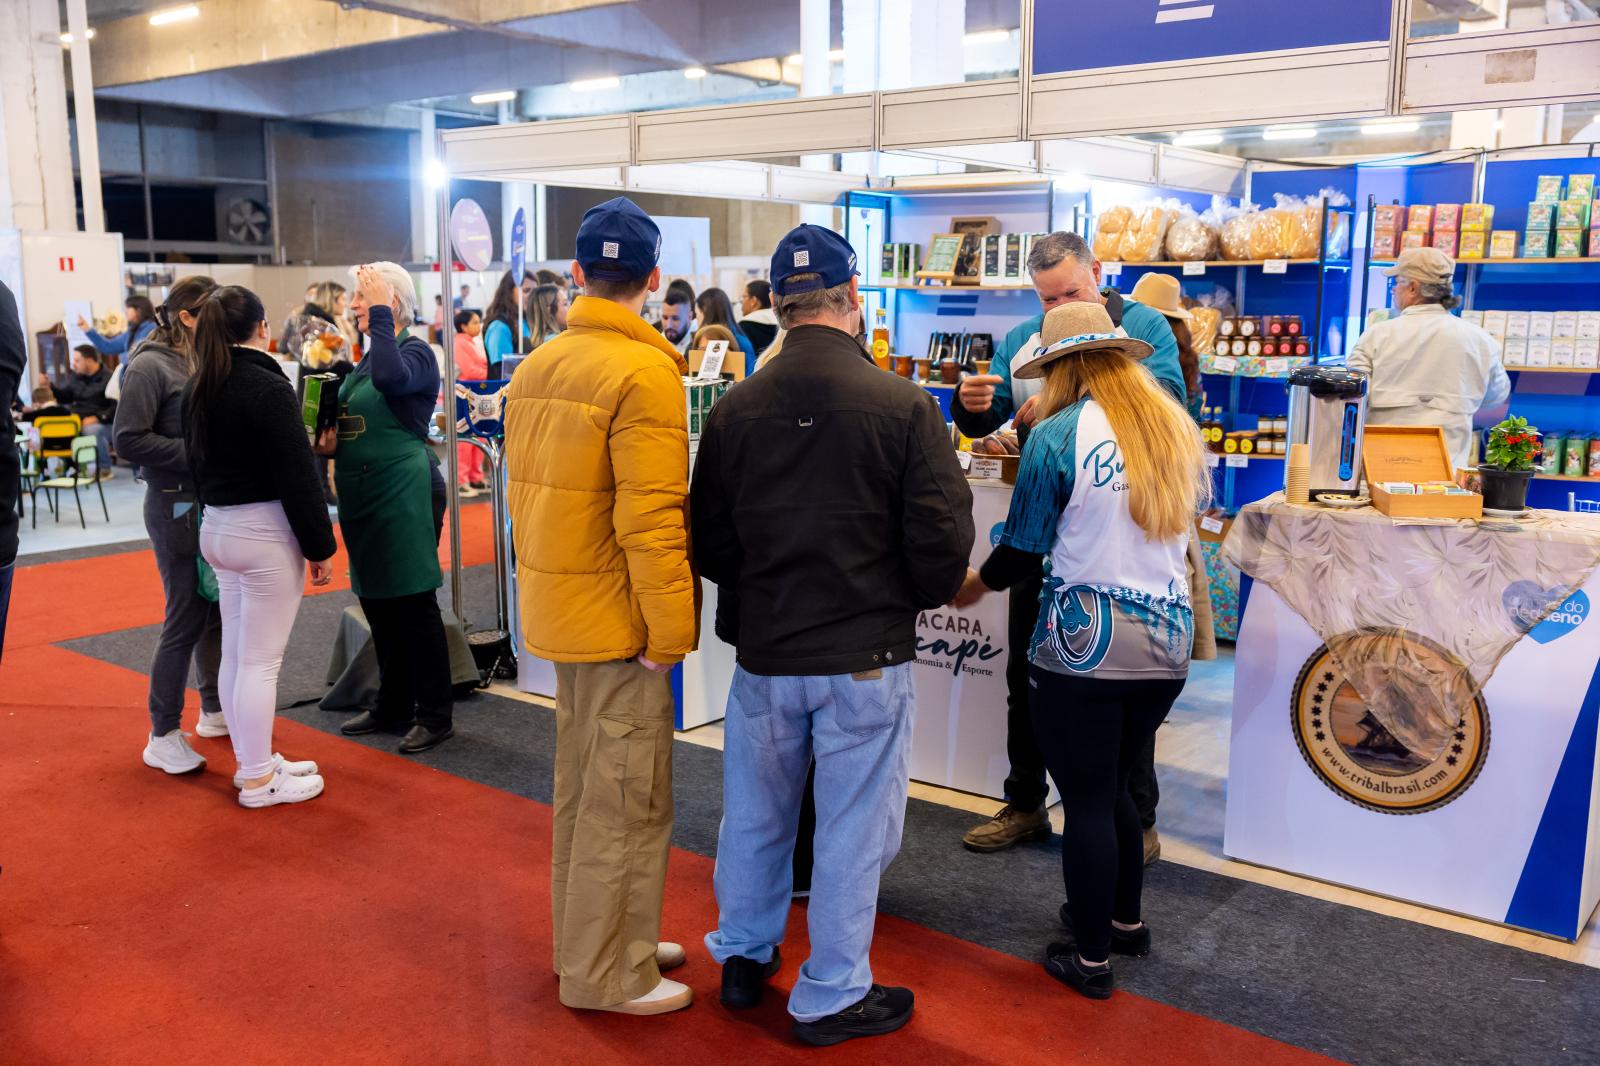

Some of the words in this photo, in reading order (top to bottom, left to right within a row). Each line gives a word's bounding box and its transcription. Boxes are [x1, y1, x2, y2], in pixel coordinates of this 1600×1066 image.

[1082, 439, 1126, 488] Bu
[1112, 481, 1130, 492] Gas
[1564, 600, 1584, 613] do
[917, 611, 983, 637] ACARA
[912, 658, 943, 668] onomia
[945, 661, 953, 670] &
[961, 663, 993, 677] Esporte
[915, 634, 1004, 677] capé
[1321, 746, 1449, 795] www.tribalbrasil.com
